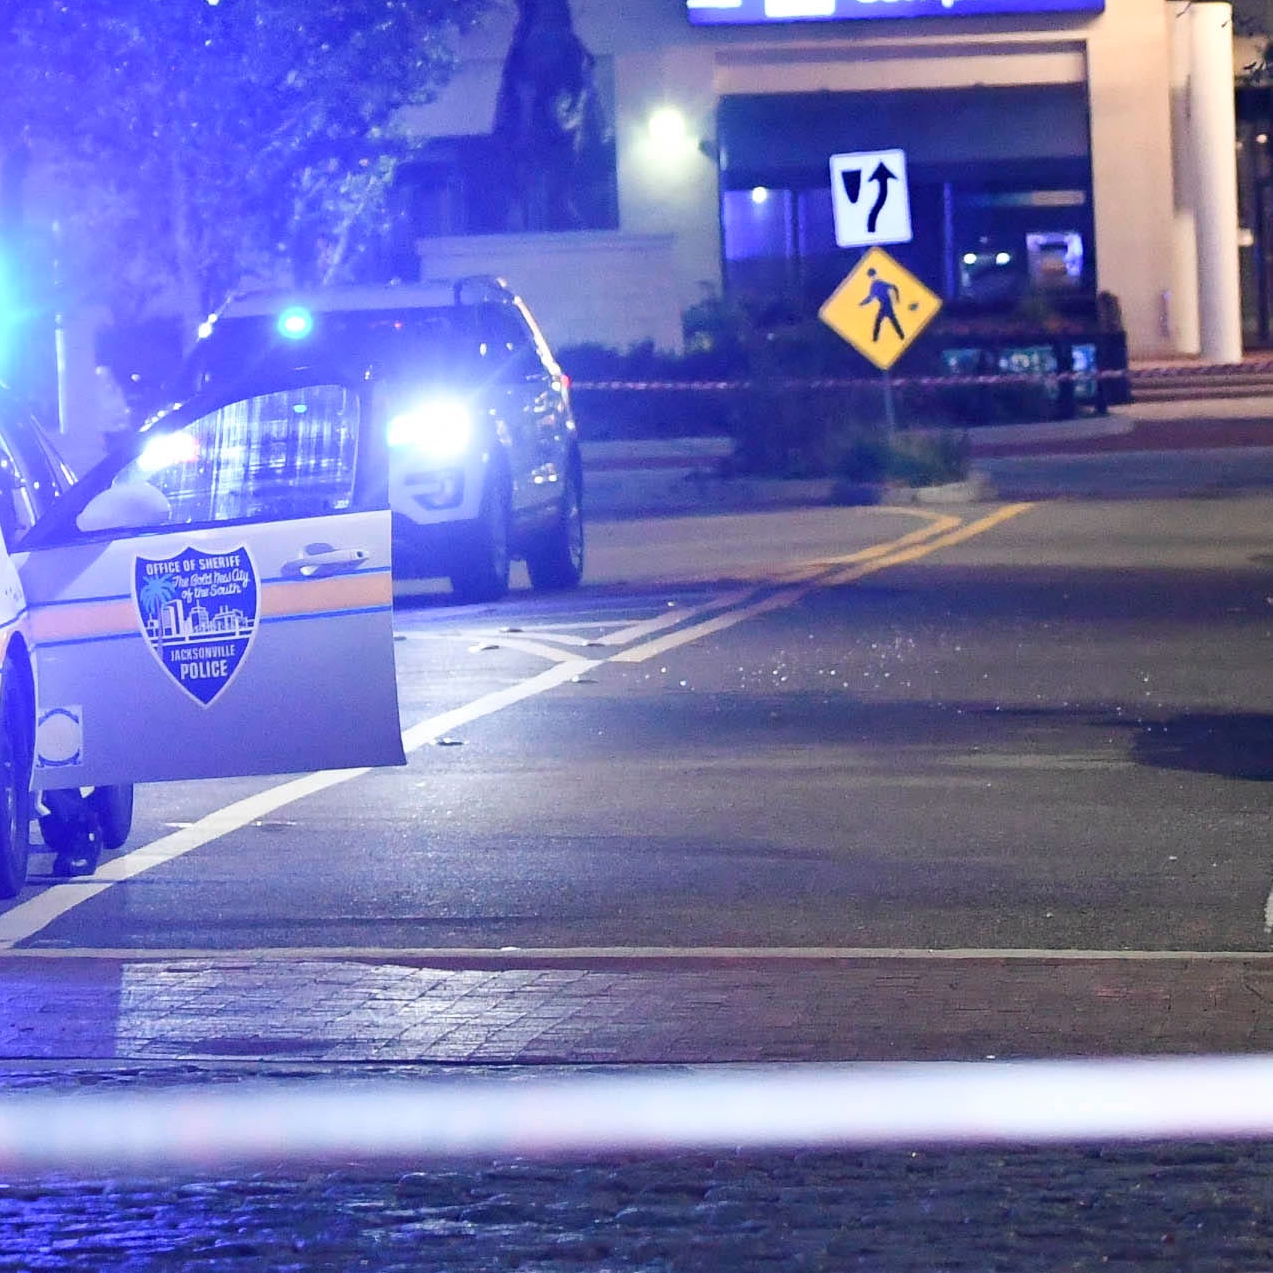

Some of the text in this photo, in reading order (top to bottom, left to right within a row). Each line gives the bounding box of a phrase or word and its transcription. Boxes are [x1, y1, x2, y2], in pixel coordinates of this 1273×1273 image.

[146, 555, 241, 576] OFFICE OF SHERIFF
[172, 575, 189, 587] The
[181, 583, 242, 603] of the South
[170, 644, 236, 662] JACKSONVILLE
[180, 659, 229, 680] POLICE
